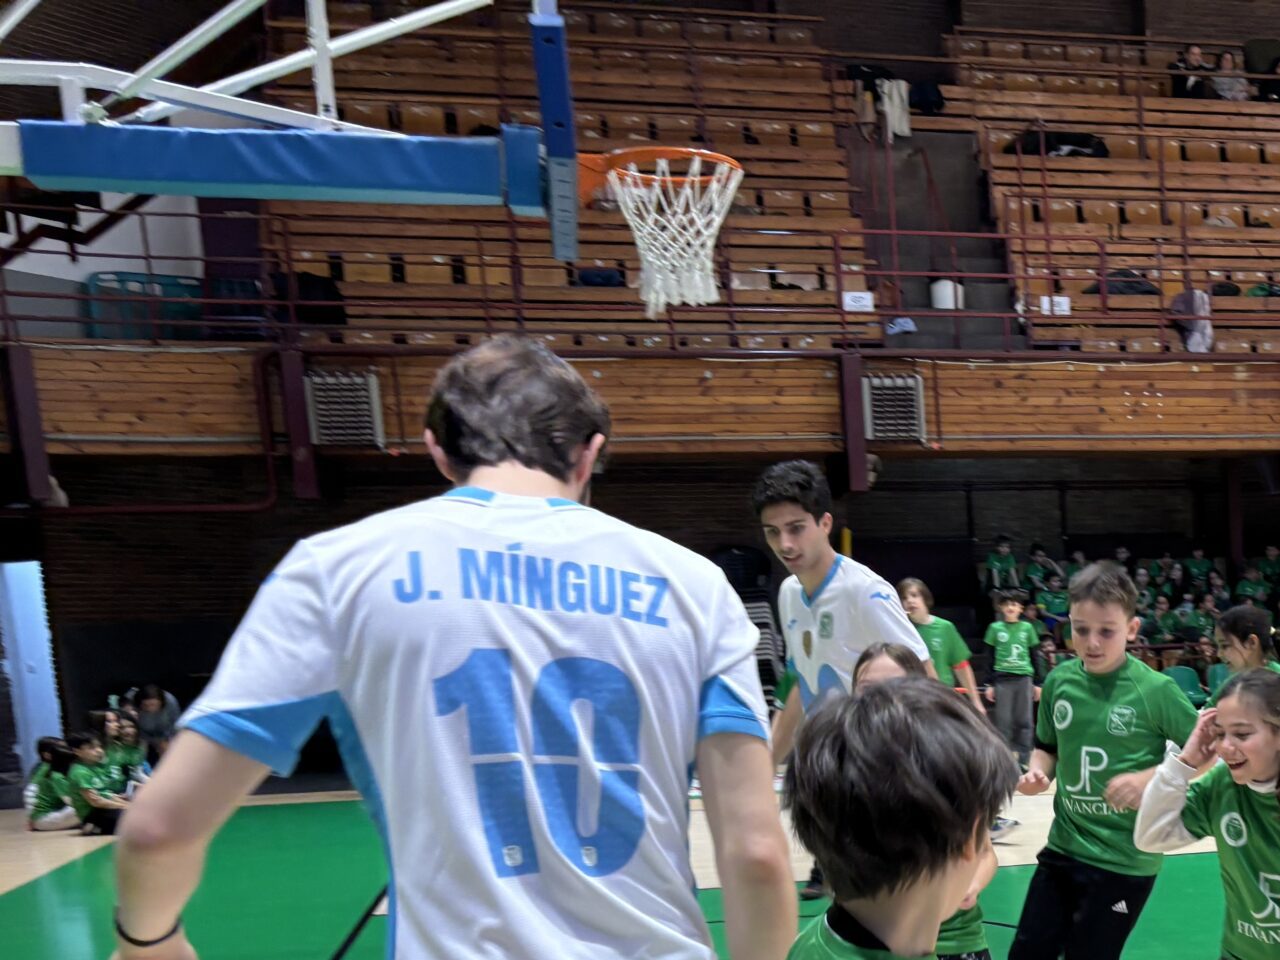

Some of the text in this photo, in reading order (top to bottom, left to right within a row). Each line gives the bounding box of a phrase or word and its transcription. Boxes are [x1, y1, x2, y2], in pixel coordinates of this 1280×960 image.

[393, 542, 670, 628] J. MÍNGUEZ
[432, 648, 646, 878] 10
